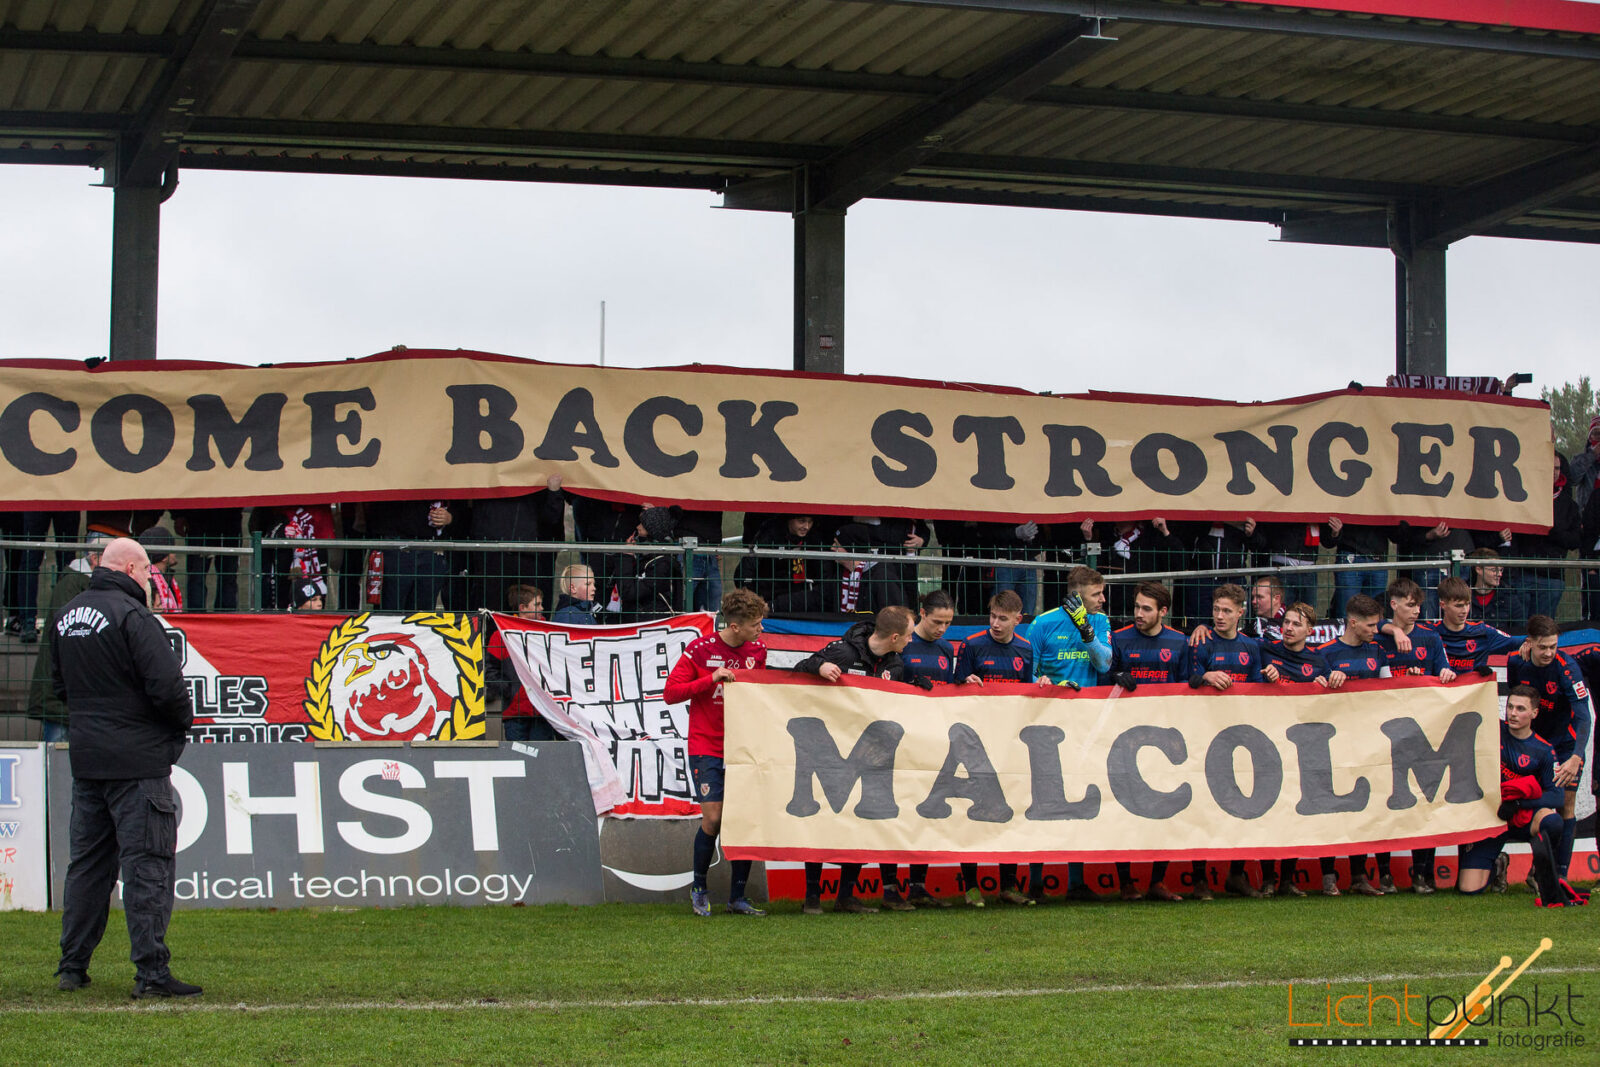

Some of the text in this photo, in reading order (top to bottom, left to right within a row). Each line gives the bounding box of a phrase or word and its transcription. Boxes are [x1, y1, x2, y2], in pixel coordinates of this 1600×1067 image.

[0, 383, 1529, 502] COME BACK STRONGER
[56, 606, 110, 637] SECURITY
[727, 658, 740, 669] 26
[1130, 670, 1169, 679] ENERGIE
[786, 711, 1483, 823] MALCOLM
[288, 868, 534, 902] technology
